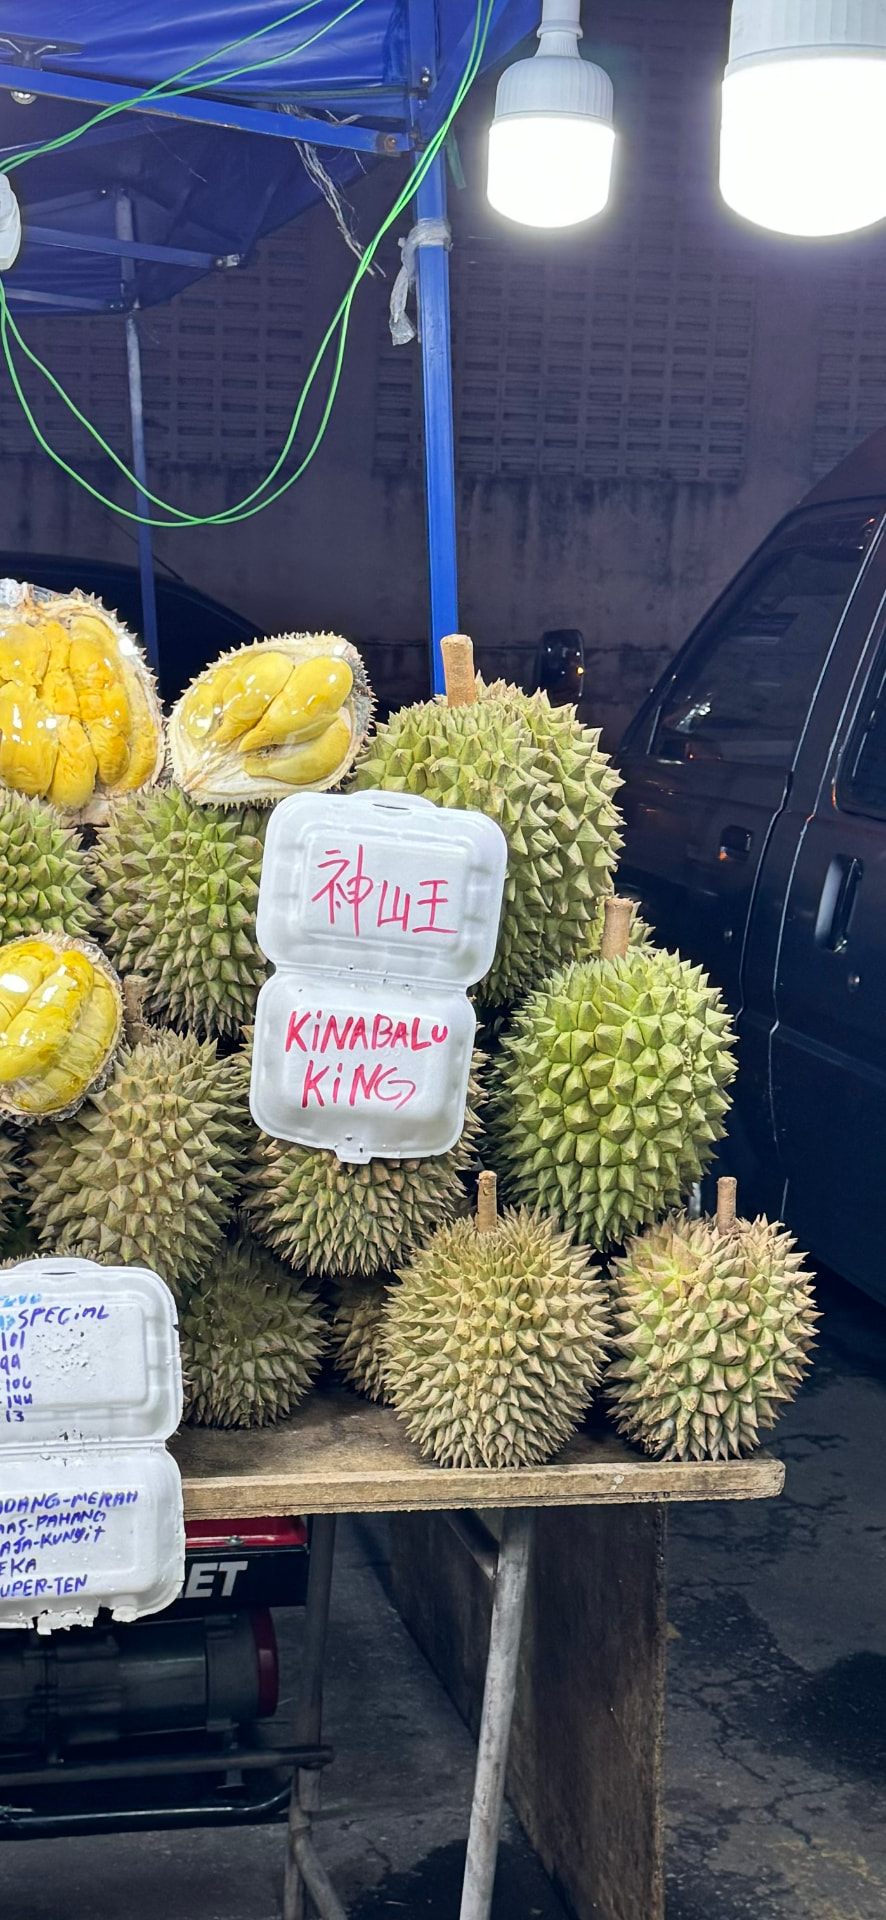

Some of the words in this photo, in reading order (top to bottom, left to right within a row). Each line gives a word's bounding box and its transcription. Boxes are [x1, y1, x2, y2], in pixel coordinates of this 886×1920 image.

[311, 844, 458, 937] 神山王
[177, 1561, 248, 1599] ET
